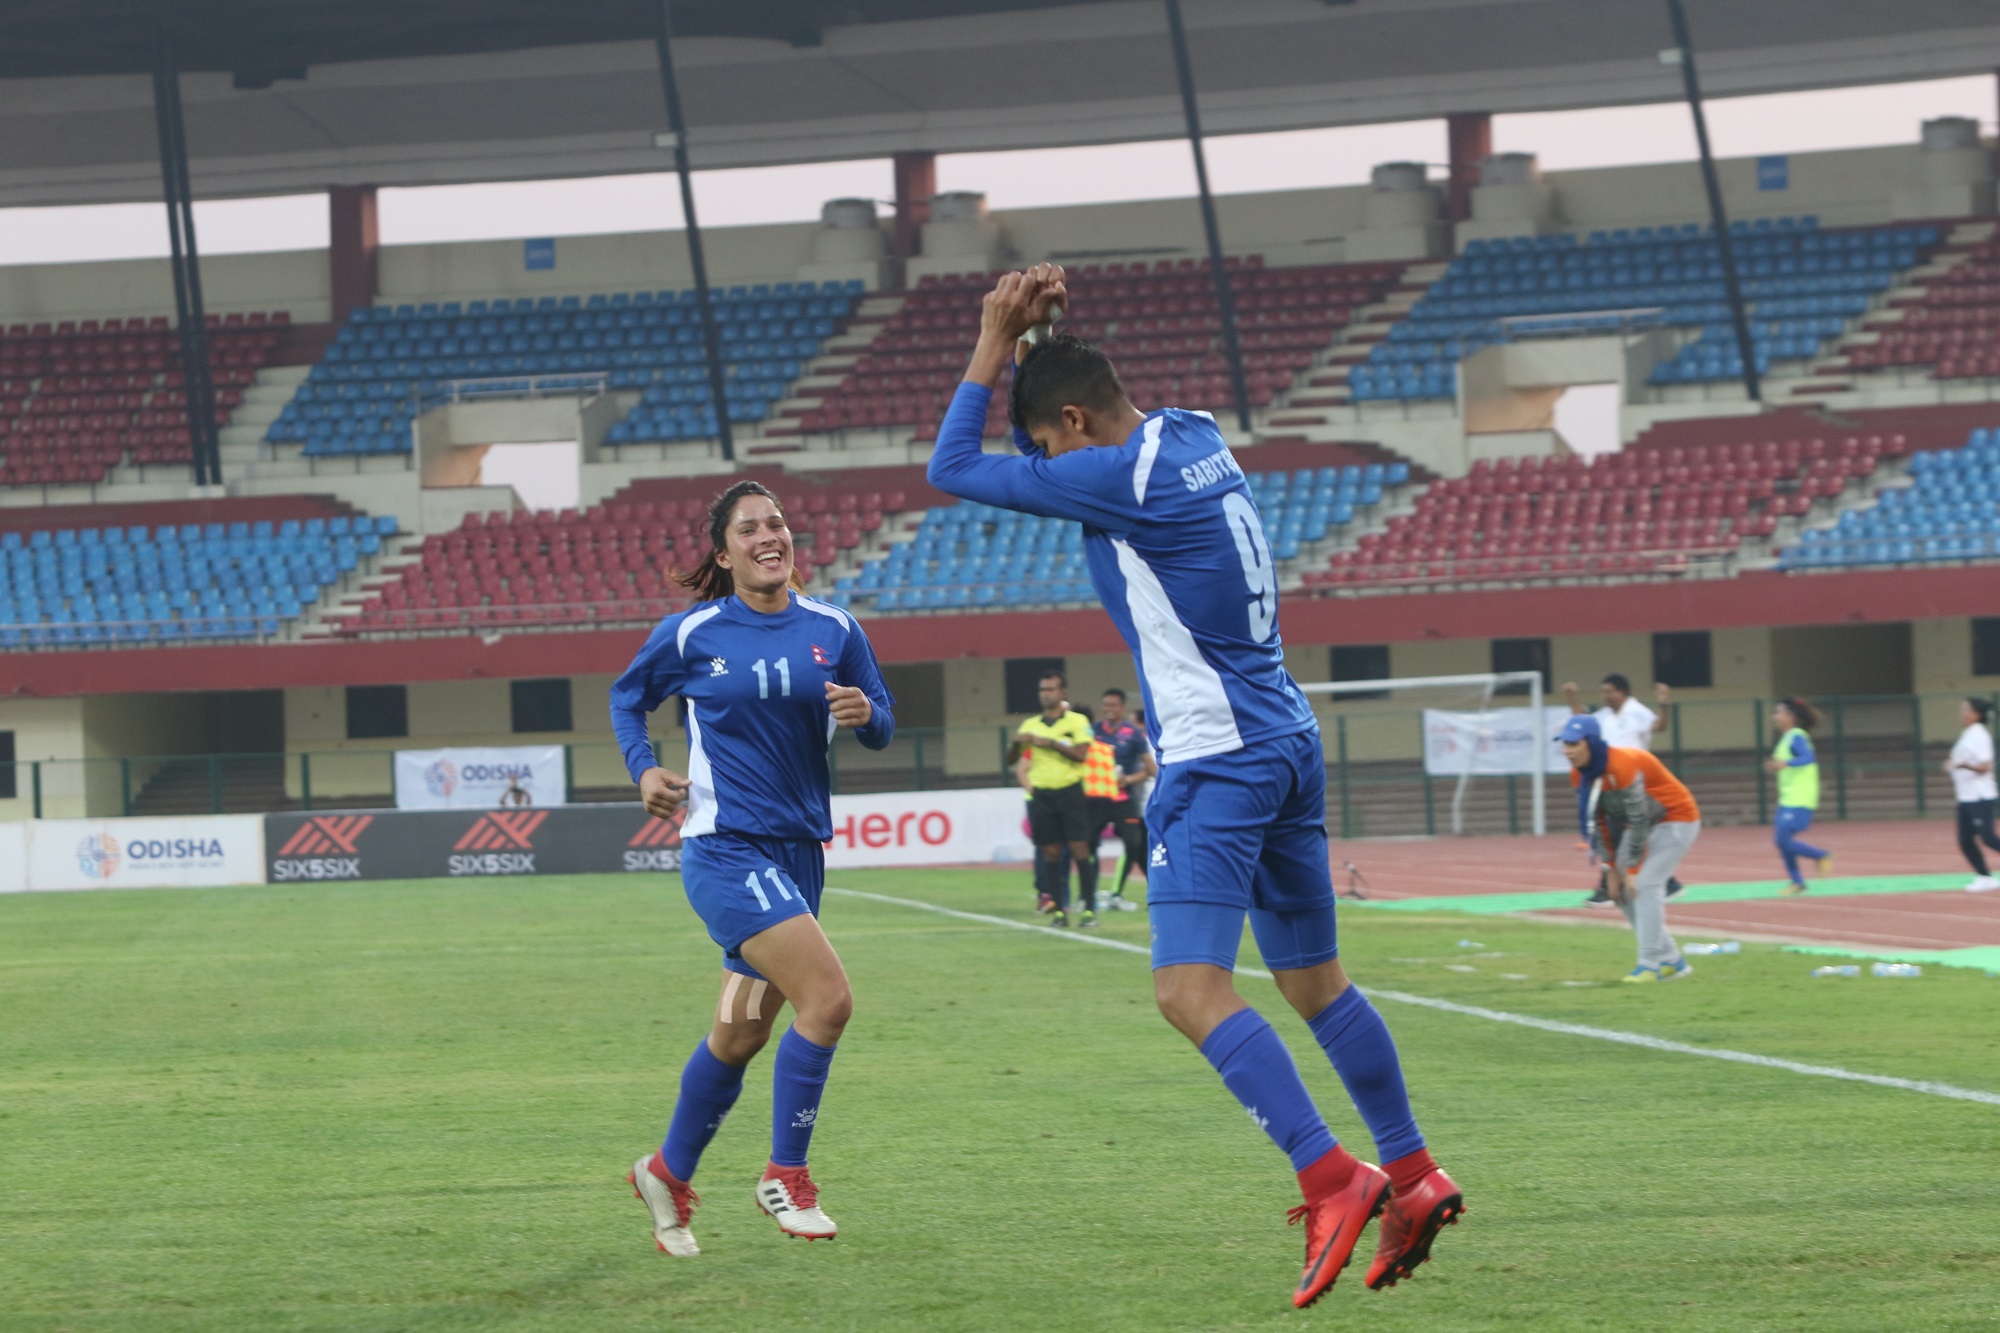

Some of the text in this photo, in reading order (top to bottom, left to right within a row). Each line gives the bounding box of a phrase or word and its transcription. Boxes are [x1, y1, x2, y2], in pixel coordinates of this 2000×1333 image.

[1222, 492, 1276, 644] 9
[751, 657, 791, 699] 11
[462, 764, 533, 781] ODISHA
[127, 838, 224, 860] ODISHA
[273, 858, 361, 880] SIX5SIX
[448, 853, 536, 876] SIX5SIX
[745, 867, 793, 912] 11
